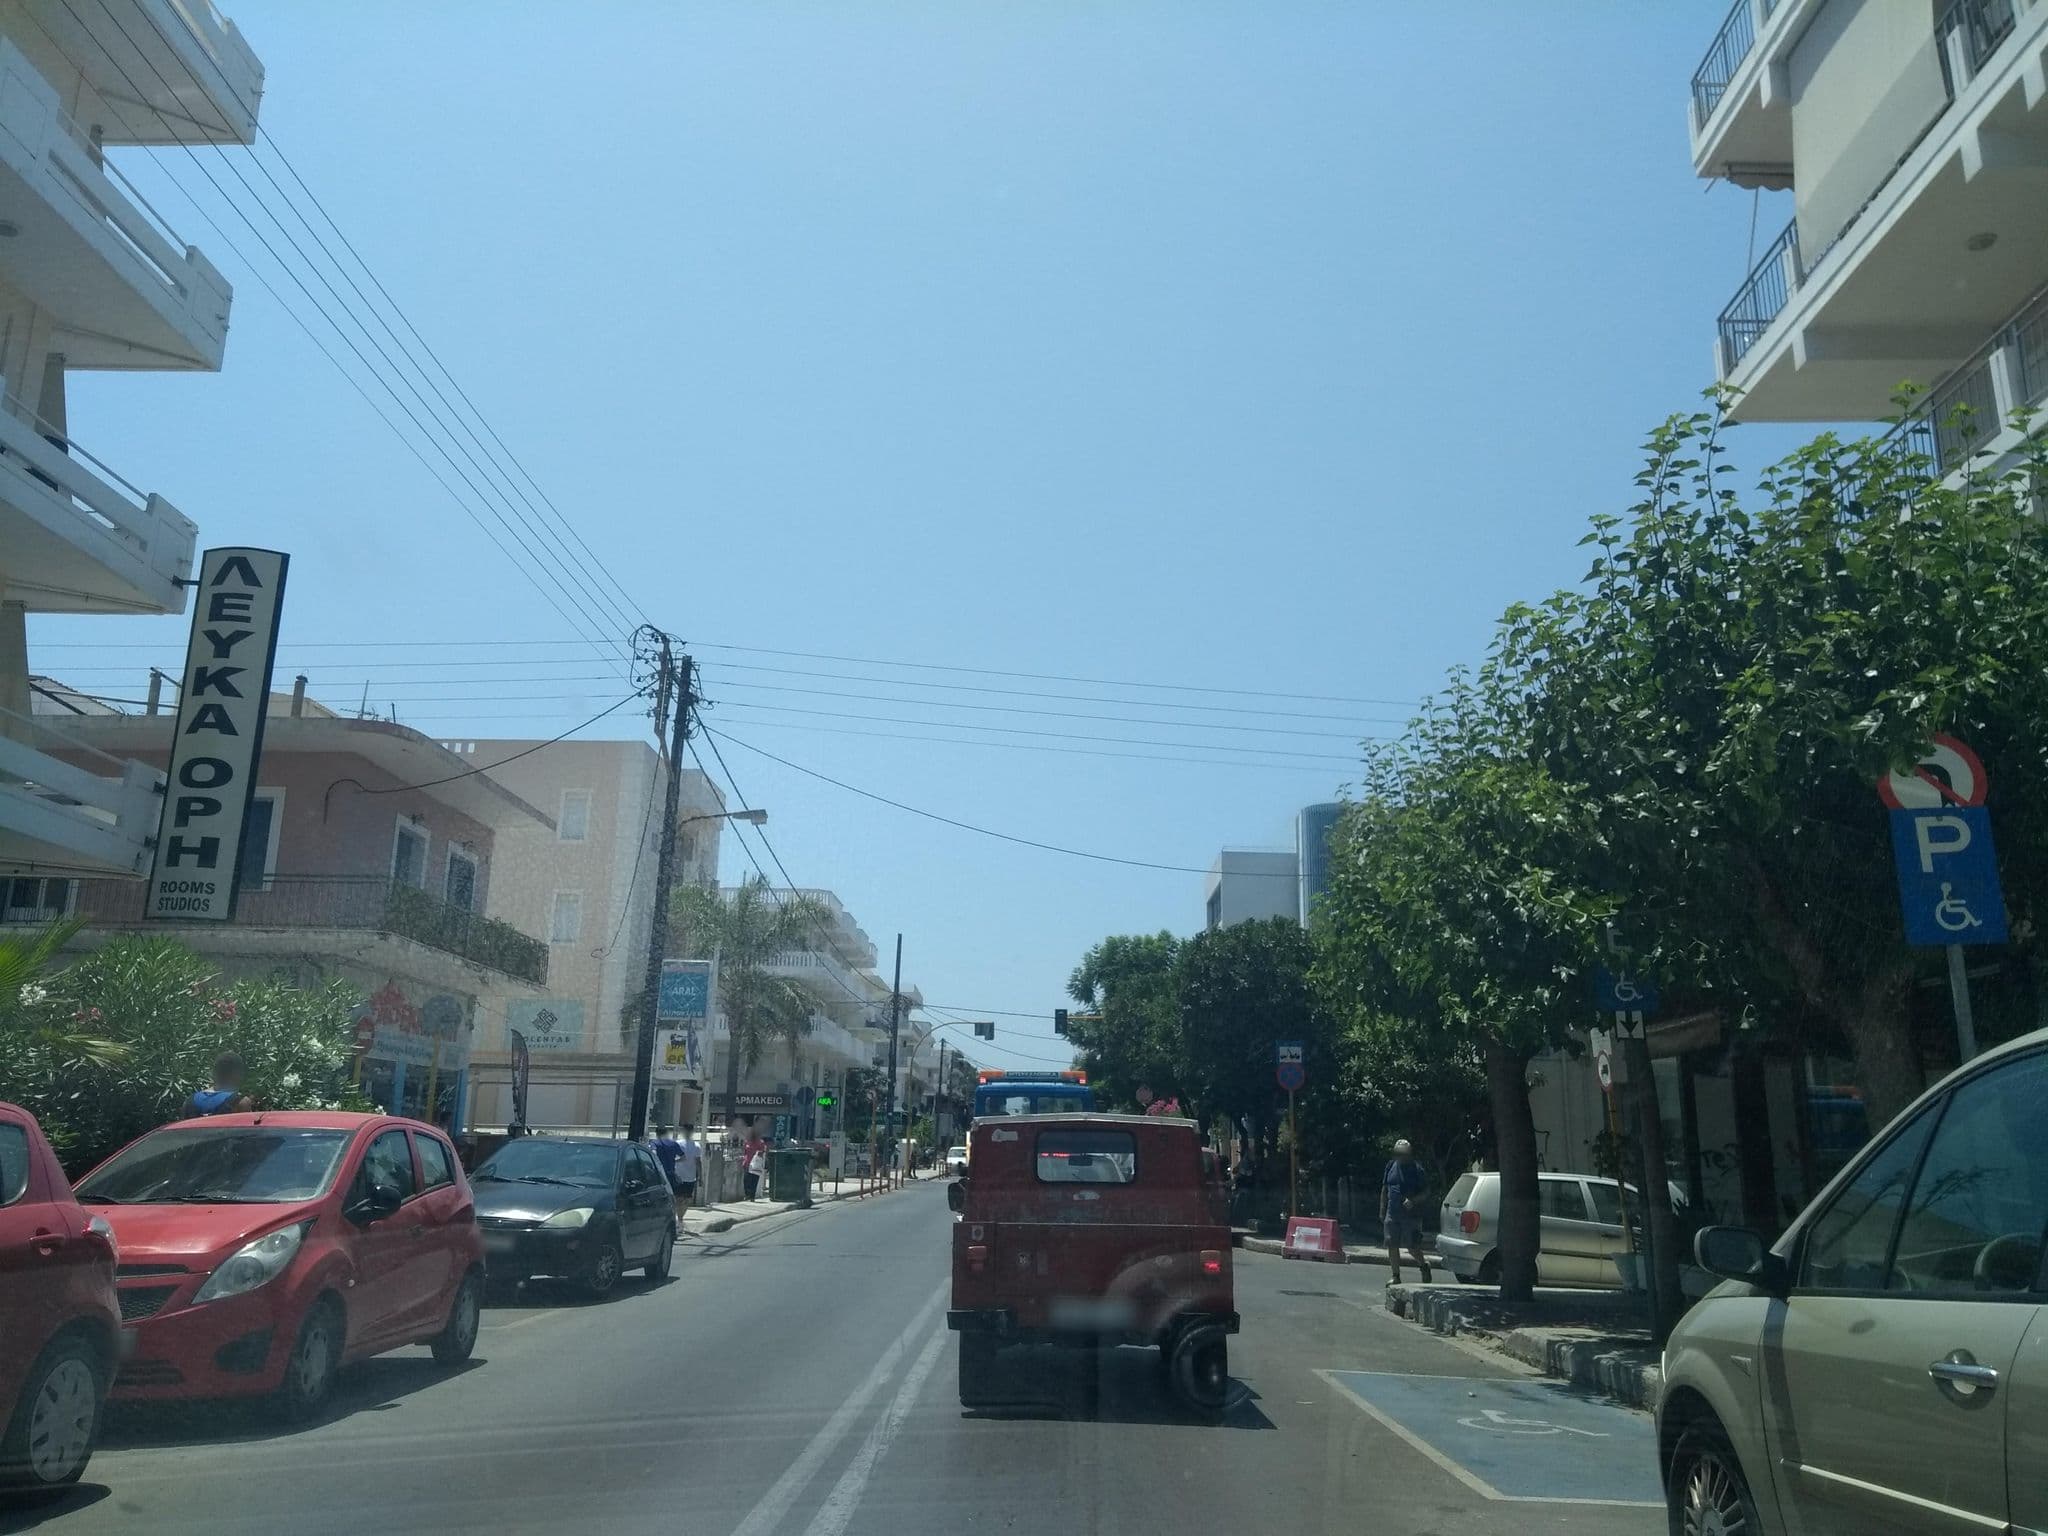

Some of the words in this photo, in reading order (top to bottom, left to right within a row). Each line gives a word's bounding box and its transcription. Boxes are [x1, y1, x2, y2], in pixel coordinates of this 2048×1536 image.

[184, 555, 263, 737] ΛΕΥΚΑ
[164, 755, 234, 870] ΟΡΗ
[1914, 815, 1971, 873] P
[157, 896, 210, 912] STUDIOS
[159, 880, 216, 896] ROOMS
[671, 986, 696, 996] ARAL
